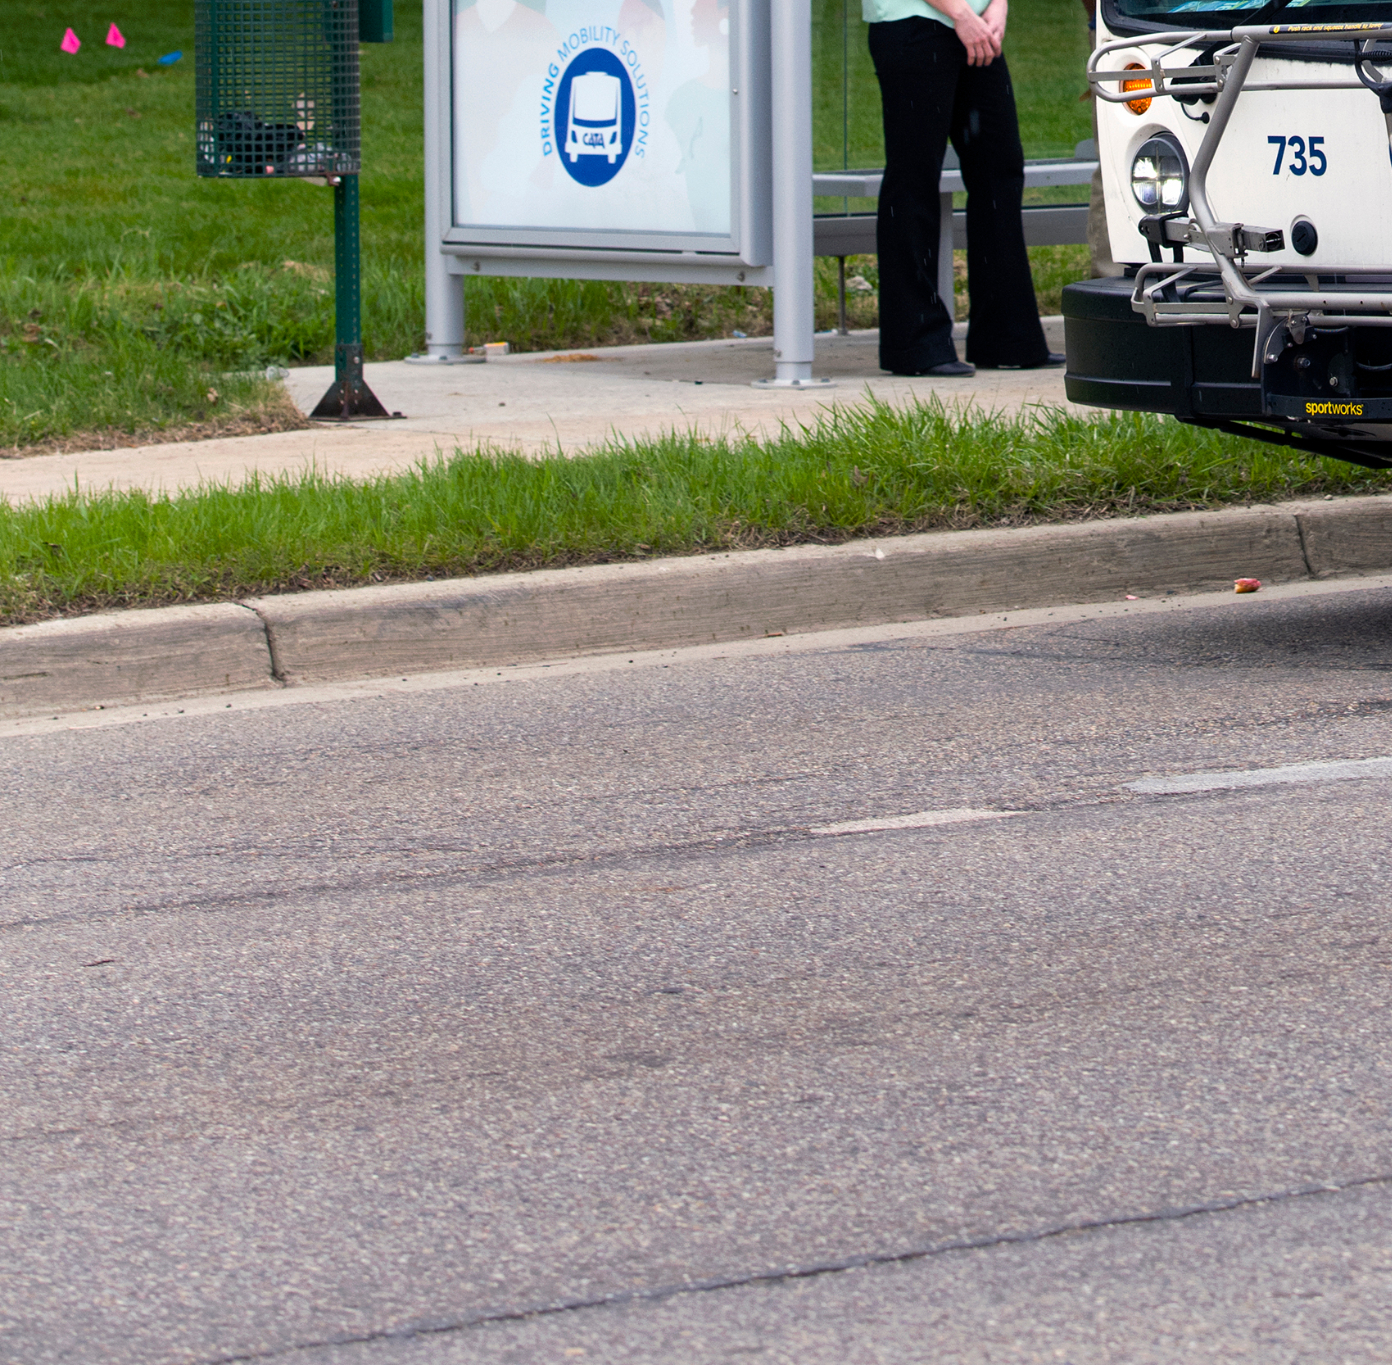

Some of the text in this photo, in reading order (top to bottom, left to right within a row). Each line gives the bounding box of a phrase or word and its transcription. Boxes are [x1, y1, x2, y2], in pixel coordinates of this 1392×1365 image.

[540, 26, 650, 158] DRIVING MOBILITY SOLUTIONS
[583, 133, 605, 149] CATA
[1267, 134, 1327, 176] 735
[1305, 401, 1363, 416] sportworks
